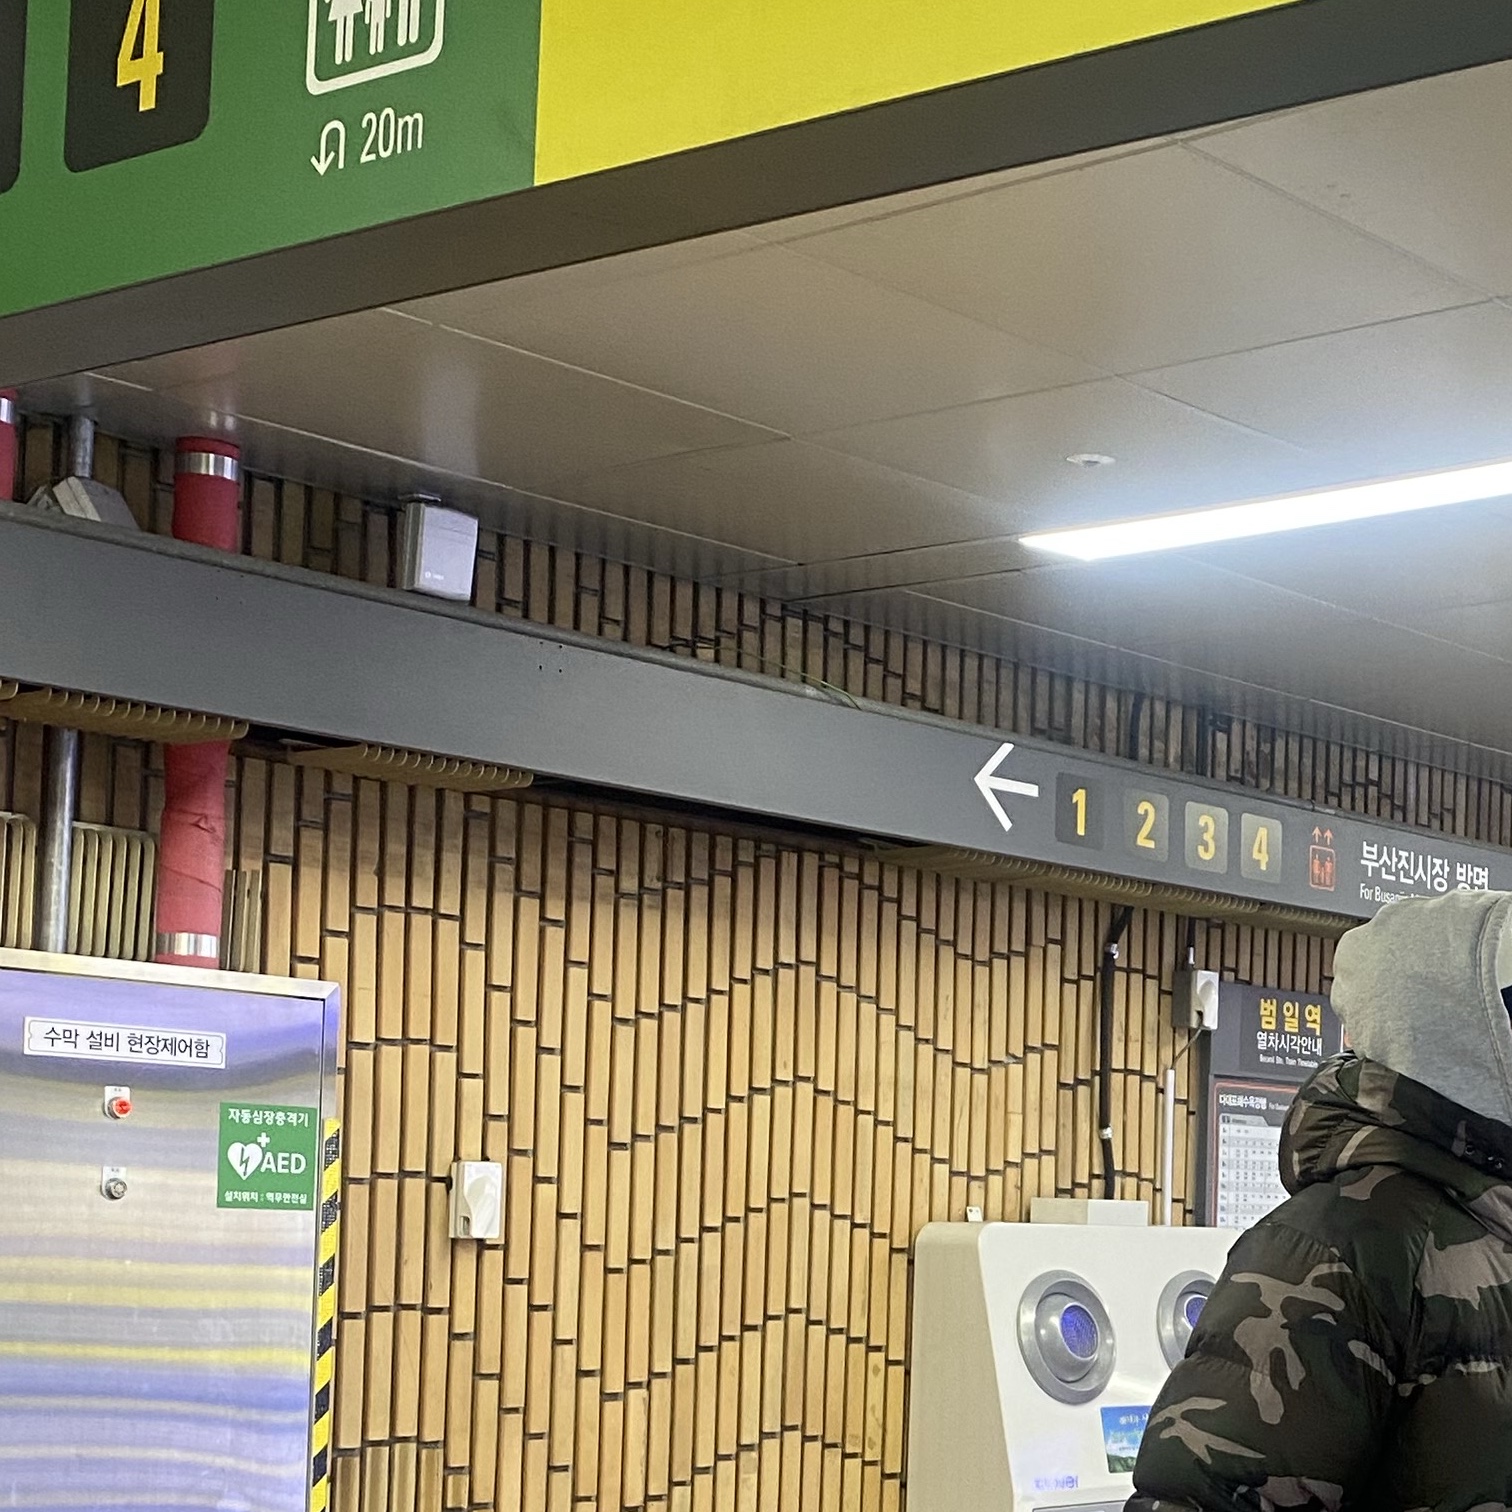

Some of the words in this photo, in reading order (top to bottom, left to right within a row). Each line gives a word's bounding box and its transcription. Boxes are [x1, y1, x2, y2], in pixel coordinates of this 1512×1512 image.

[116, 0, 164, 112] 4
[360, 107, 424, 164] 20m
[1072, 788, 1087, 836] 1
[1136, 800, 1156, 849] 2
[1197, 814, 1216, 861] 3
[1252, 826, 1269, 871] 4
[1360, 841, 1450, 892] 부산진시장
[1456, 862, 1489, 891] 방면
[1360, 883, 1373, 900] For
[1260, 998, 1322, 1036] 범일역
[43, 1027, 80, 1049] 수막
[86, 1030, 120, 1052] 설비
[127, 1033, 210, 1059] 현장제어함
[1257, 1031, 1322, 1056] 열차시각안내
[228, 1108, 309, 1128] 자동심장충격기
[260, 1151, 307, 1174] AED
